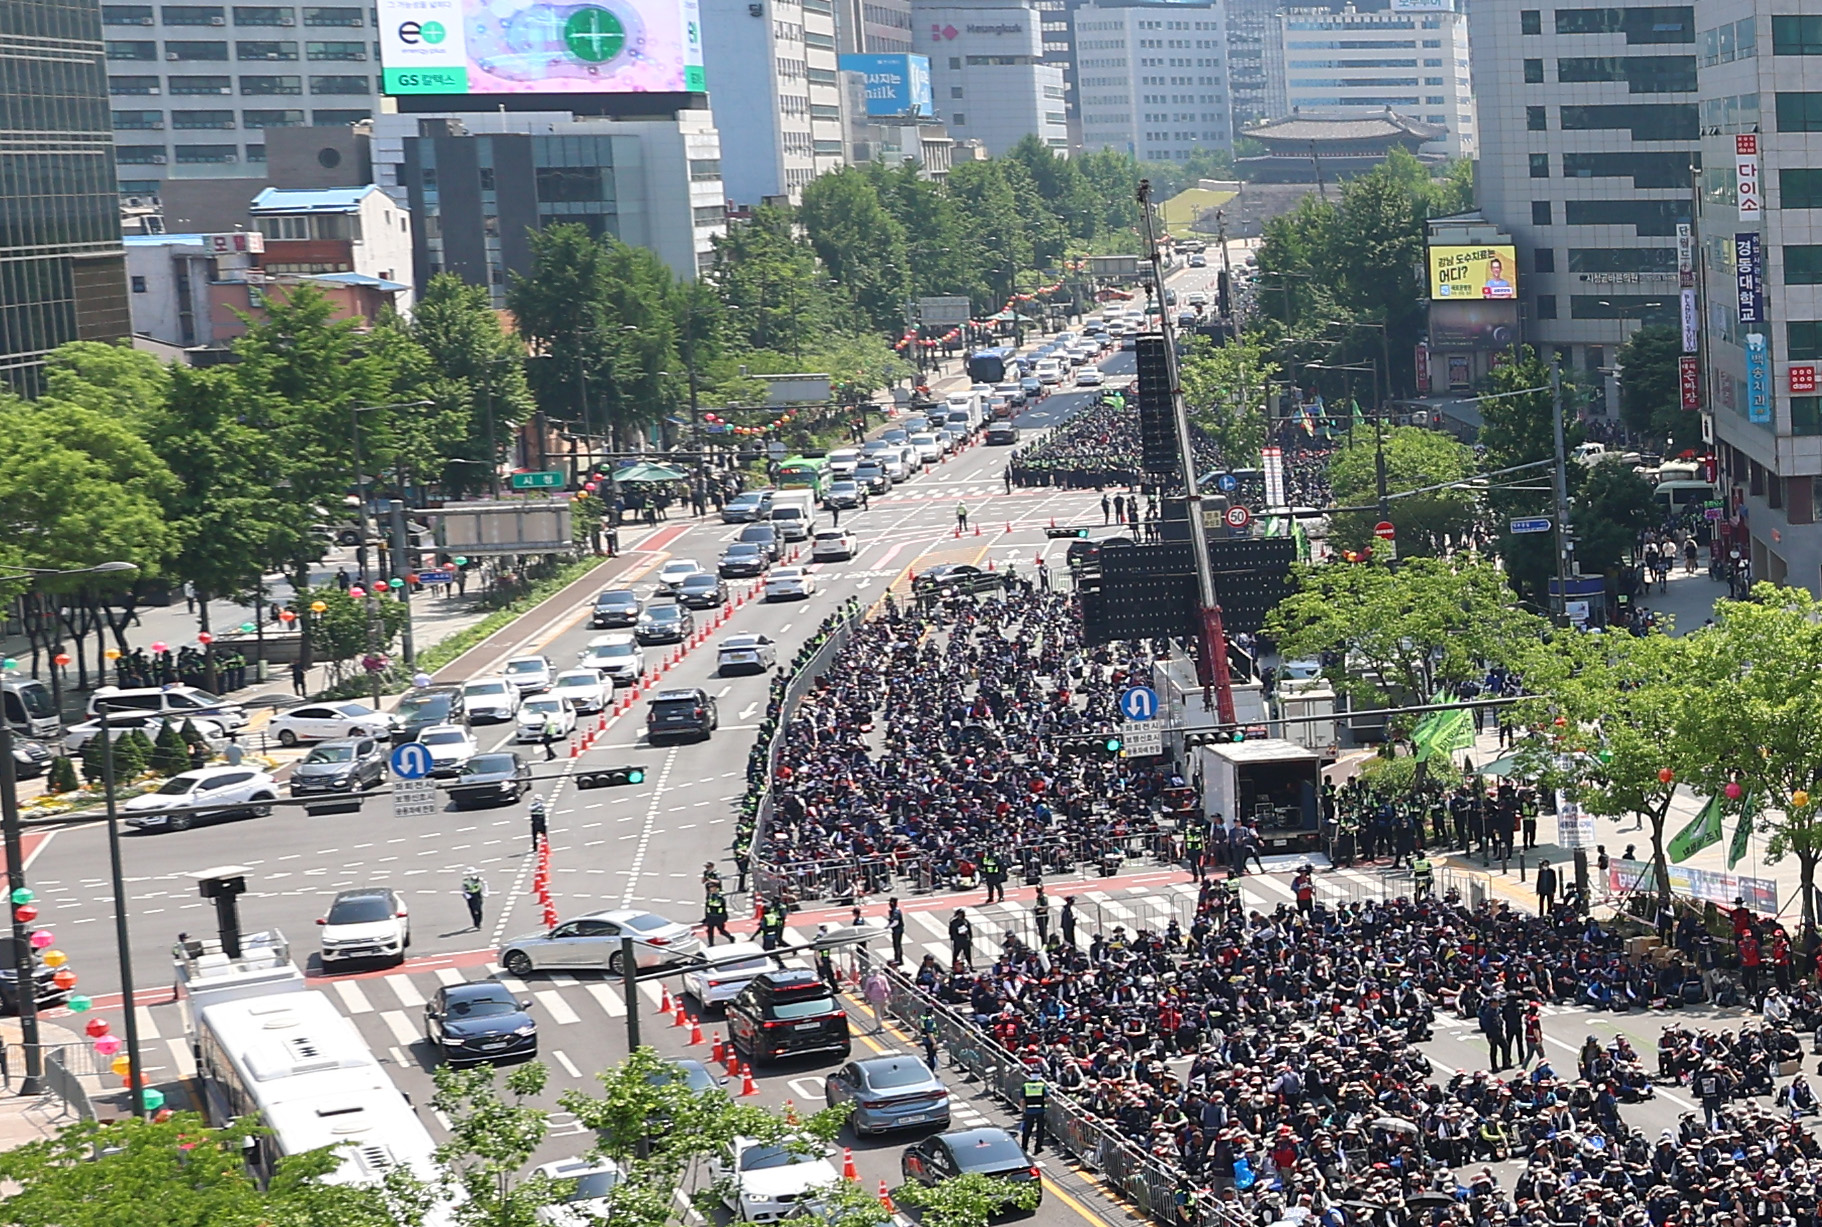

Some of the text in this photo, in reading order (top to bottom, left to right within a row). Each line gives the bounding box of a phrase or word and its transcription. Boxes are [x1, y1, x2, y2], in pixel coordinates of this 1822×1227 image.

[966, 23, 1022, 36] Heungkuk
[399, 74, 455, 86] GS 칼텍스
[1739, 164, 1758, 211] 다이소
[1438, 257, 1454, 267] 강남
[1439, 266, 1468, 282] 어디?
[1737, 240, 1756, 321] 경동대학교
[1231, 511, 1244, 522] 50
